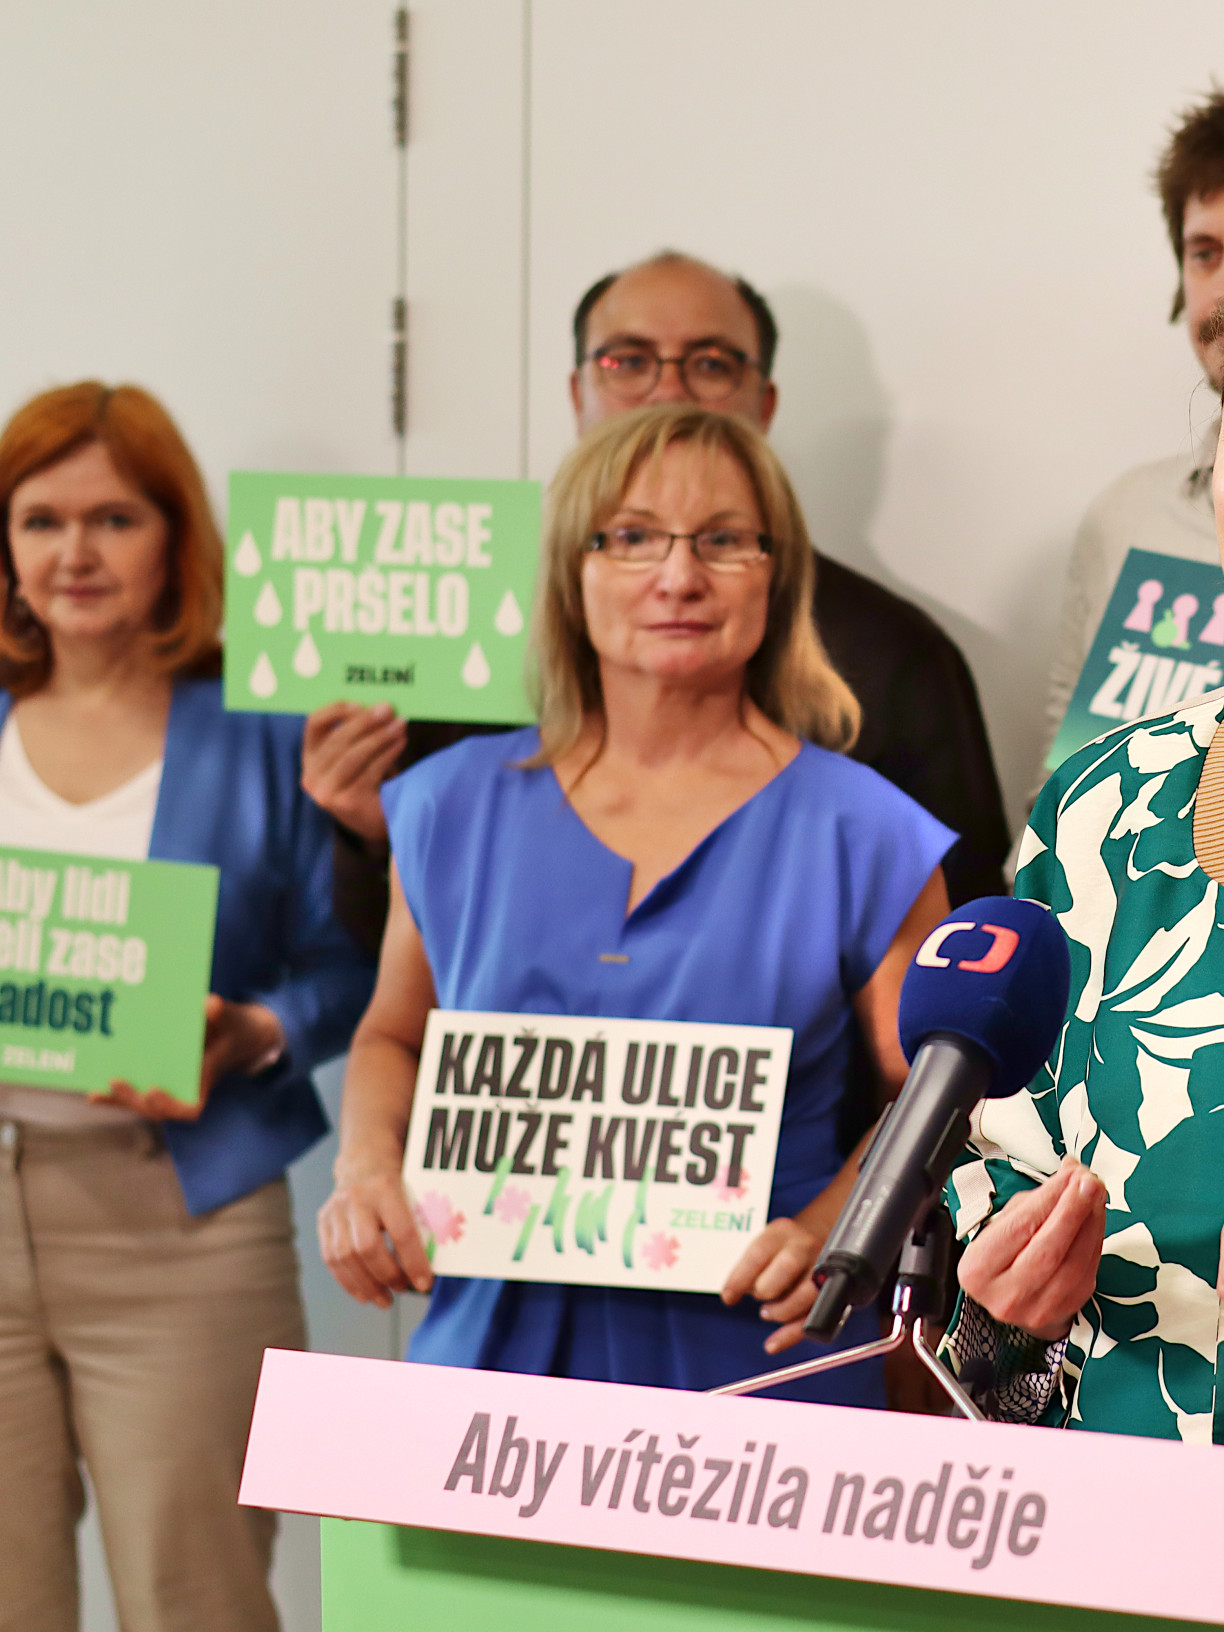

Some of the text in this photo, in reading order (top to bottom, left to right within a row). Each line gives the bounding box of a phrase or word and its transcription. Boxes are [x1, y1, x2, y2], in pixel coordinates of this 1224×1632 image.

[271, 497, 493, 568] ABY ZASE
[293, 563, 470, 638] PRŠELO
[346, 662, 416, 685] ZELENÍ
[0, 858, 57, 920] by
[47, 926, 148, 985] zase
[0, 980, 114, 1036] adost
[436, 1026, 772, 1112] KAŽDÁ ULICE
[583, 1110, 754, 1188] KVÉST
[669, 1207, 755, 1232] ZELENÍ
[444, 1412, 1047, 1570] Aby vítězila naděje
